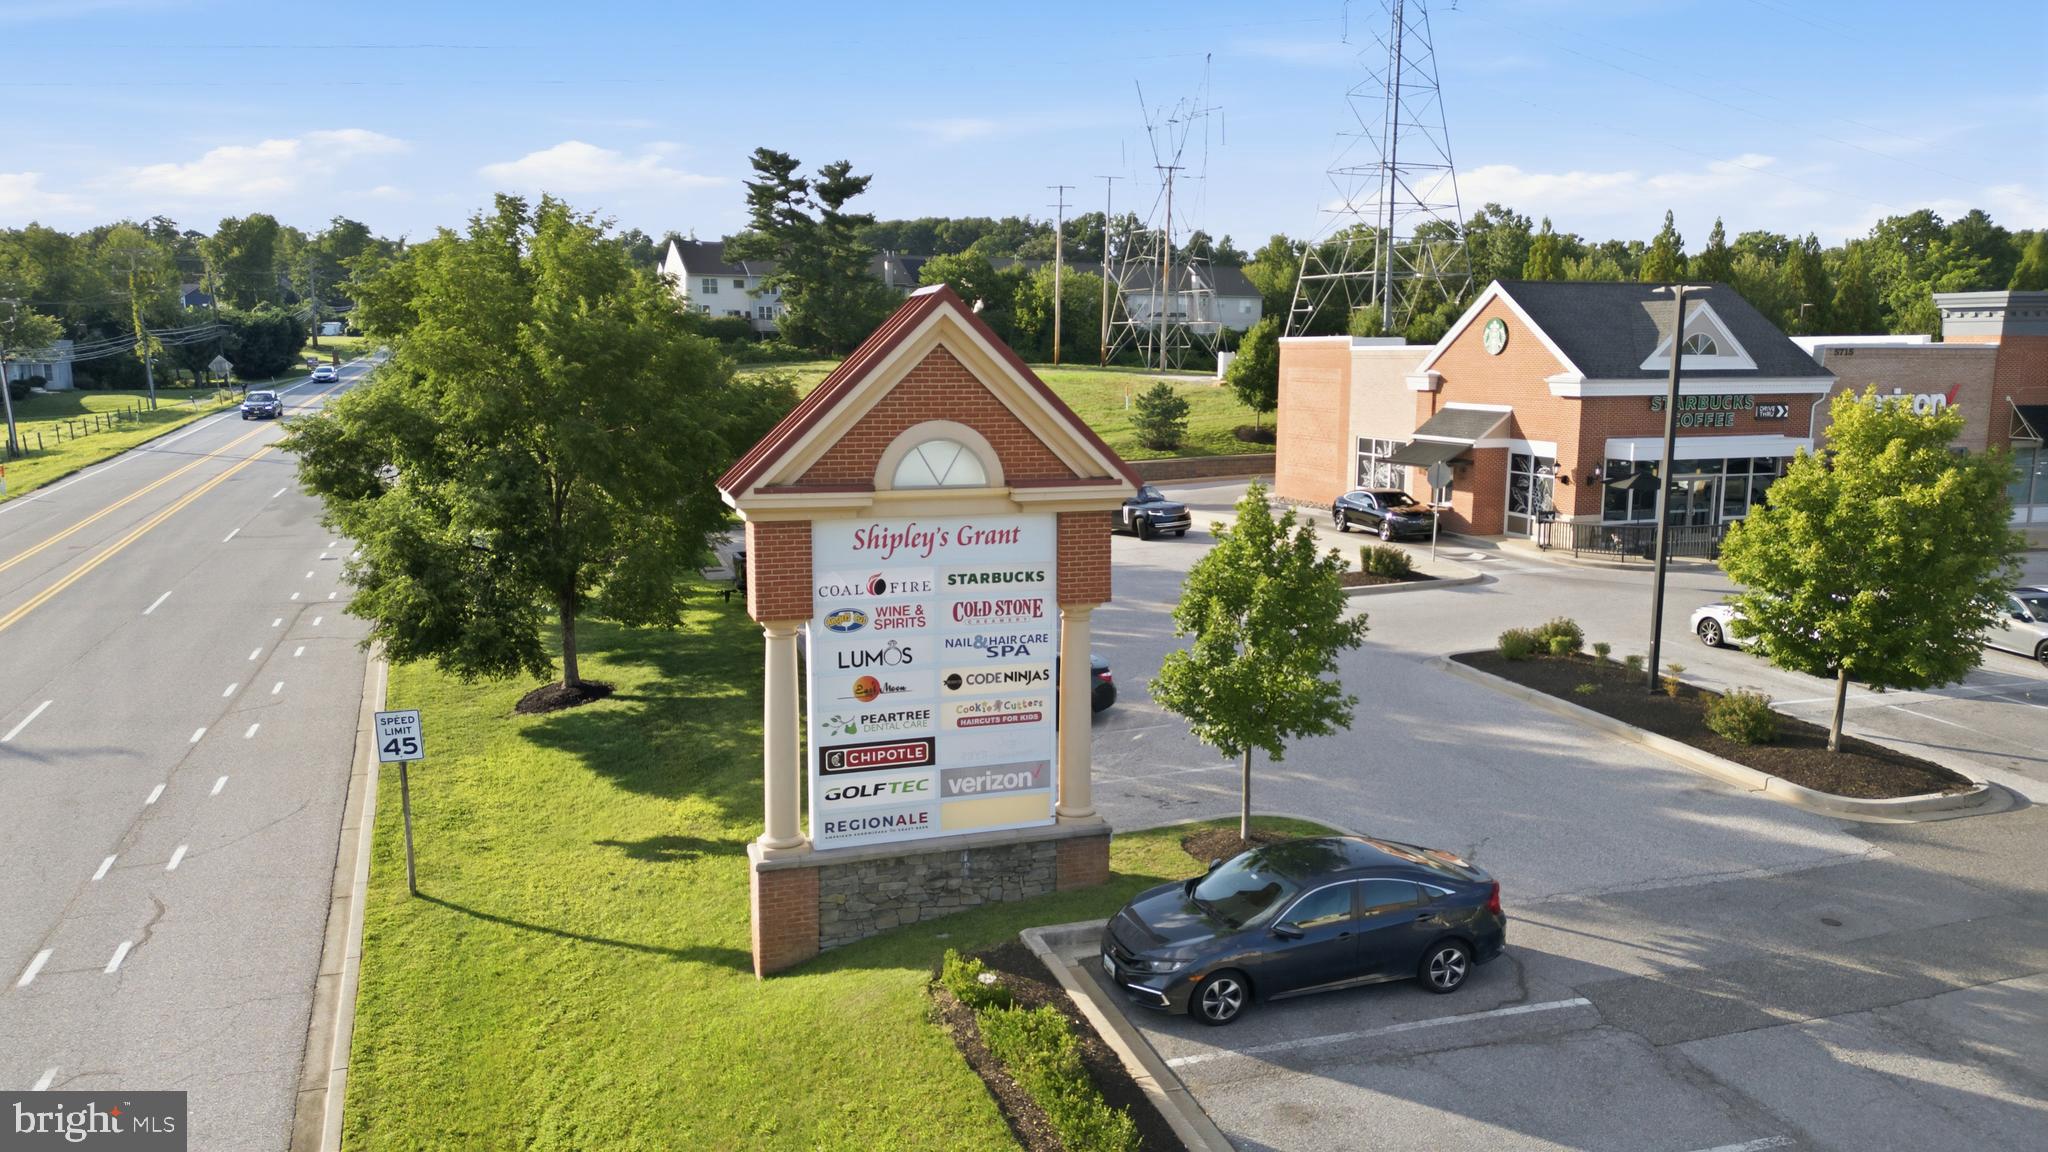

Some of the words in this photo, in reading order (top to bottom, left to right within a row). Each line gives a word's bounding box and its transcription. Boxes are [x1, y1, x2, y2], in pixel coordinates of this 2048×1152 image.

[853, 522, 949, 560] Shipley's
[957, 524, 1021, 546] Grant
[947, 570, 1045, 586] STARBUCKS
[818, 584, 864, 597] COAL
[889, 580, 932, 594] FIRE
[875, 605, 911, 618] WINE
[915, 604, 924, 616] &
[952, 601, 992, 623] COLD
[994, 598, 1043, 618] STONE
[874, 616, 926, 630] SPIRITS
[945, 637, 972, 649] NAIL
[989, 635, 1018, 646] HAIR
[1020, 633, 1049, 645] CARE
[838, 643, 913, 669] LUMOS
[986, 644, 1031, 658] SPA
[1004, 669, 1050, 686] NINJAS
[380, 716, 415, 725] SPEED
[861, 710, 930, 724] PEARTREE
[960, 717, 1001, 726] HAIRCUTS
[1002, 715, 1018, 723] FOR
[1020, 713, 1039, 721] KIDS
[385, 726, 412, 736] LIMIT
[863, 723, 900, 733] DENTAL
[903, 720, 928, 729] CARE
[383, 737, 418, 756] 45
[849, 747, 924, 764] CHIPOTLE
[948, 771, 1033, 794] verizon
[825, 812, 928, 834] REGIONALE
